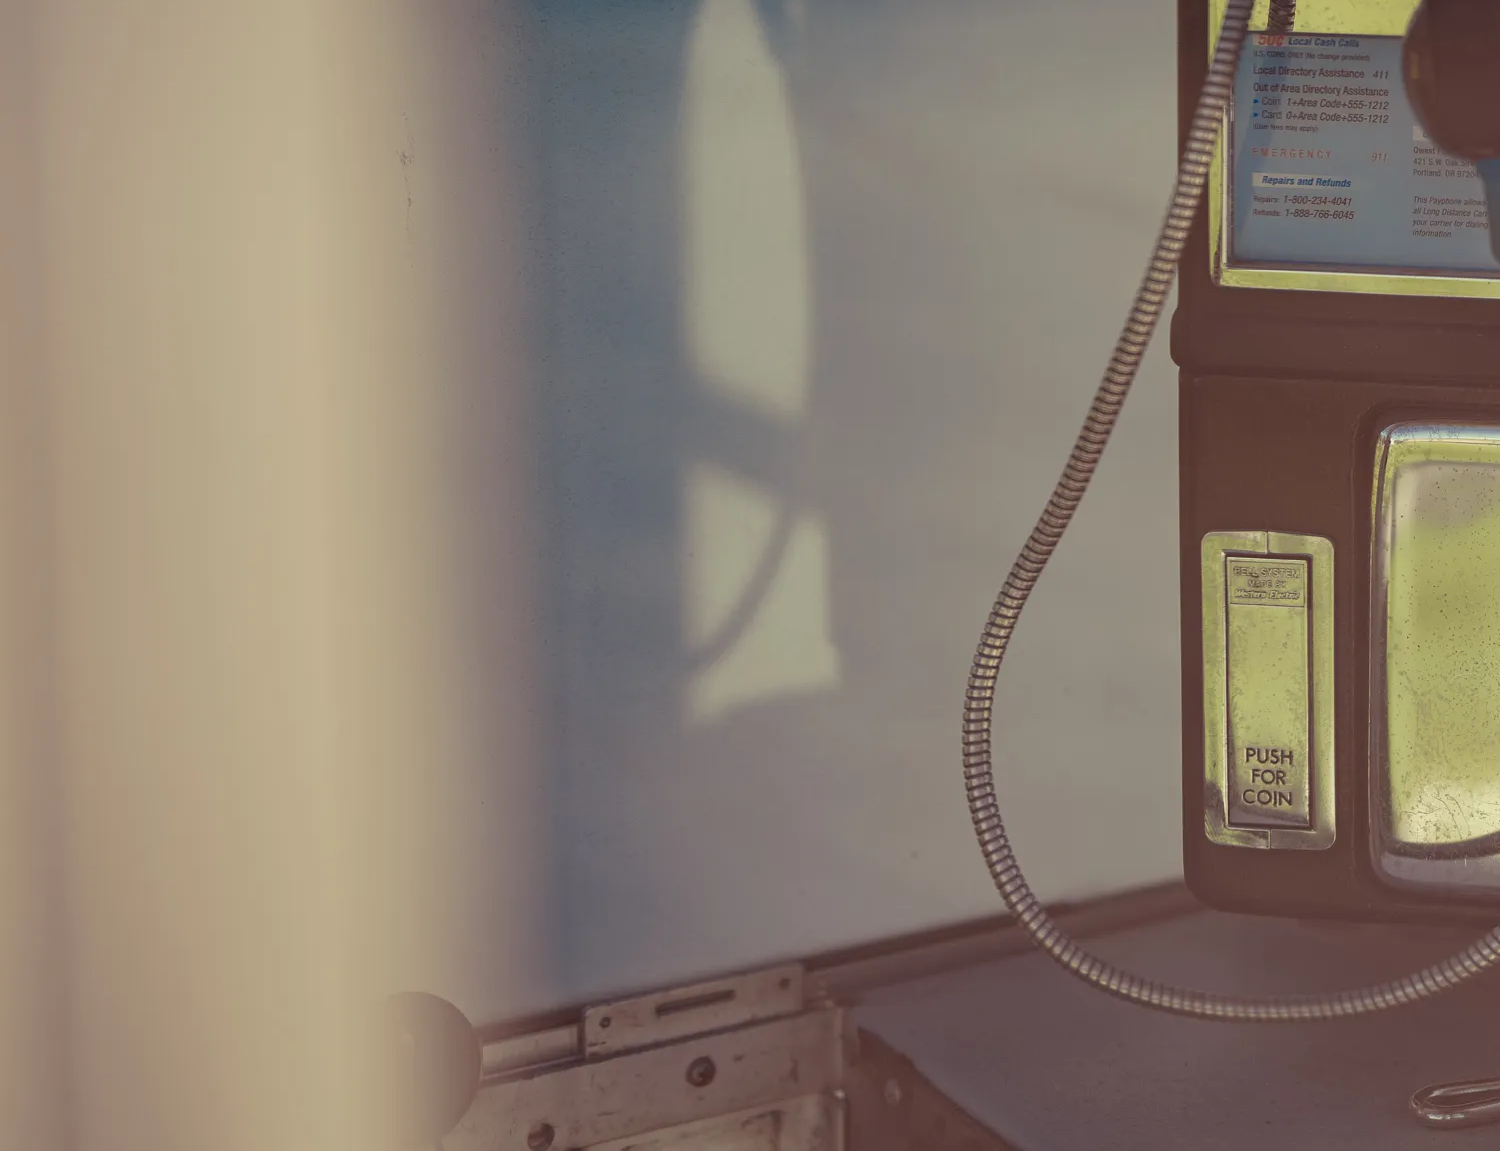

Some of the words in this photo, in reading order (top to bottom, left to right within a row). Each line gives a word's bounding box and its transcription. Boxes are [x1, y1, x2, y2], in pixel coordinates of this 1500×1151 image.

[1288, 37, 1311, 45] Local
[1314, 38, 1336, 46] Cash
[1339, 38, 1359, 47] Calls
[1317, 53, 1339, 61] change
[1253, 66, 1276, 75] Local
[1278, 66, 1316, 78] Directory
[1319, 68, 1364, 78] Assistance
[1373, 71, 1389, 79] 411
[1253, 83, 1268, 91] Out
[1270, 83, 1279, 92] of
[1281, 84, 1300, 93] Area
[1303, 85, 1341, 96] Directory
[1343, 86, 1389, 96] Assistance
[1252, 147, 1332, 159] EMERGENCY
[1372, 153, 1388, 162] 911
[1262, 176, 1294, 185] Repairs
[1297, 178, 1313, 186] and
[1316, 178, 1351, 187] Refunds
[1429, 197, 1462, 205] Payphone
[1424, 208, 1439, 216] Long
[1260, 568, 1300, 578] SYSTEM
[1248, 580, 1272, 588] MADE
[1269, 590, 1300, 600] Electric
[1245, 747, 1293, 765] PUSH
[1252, 769, 1285, 785] FOR
[1242, 789, 1292, 806] COIN
